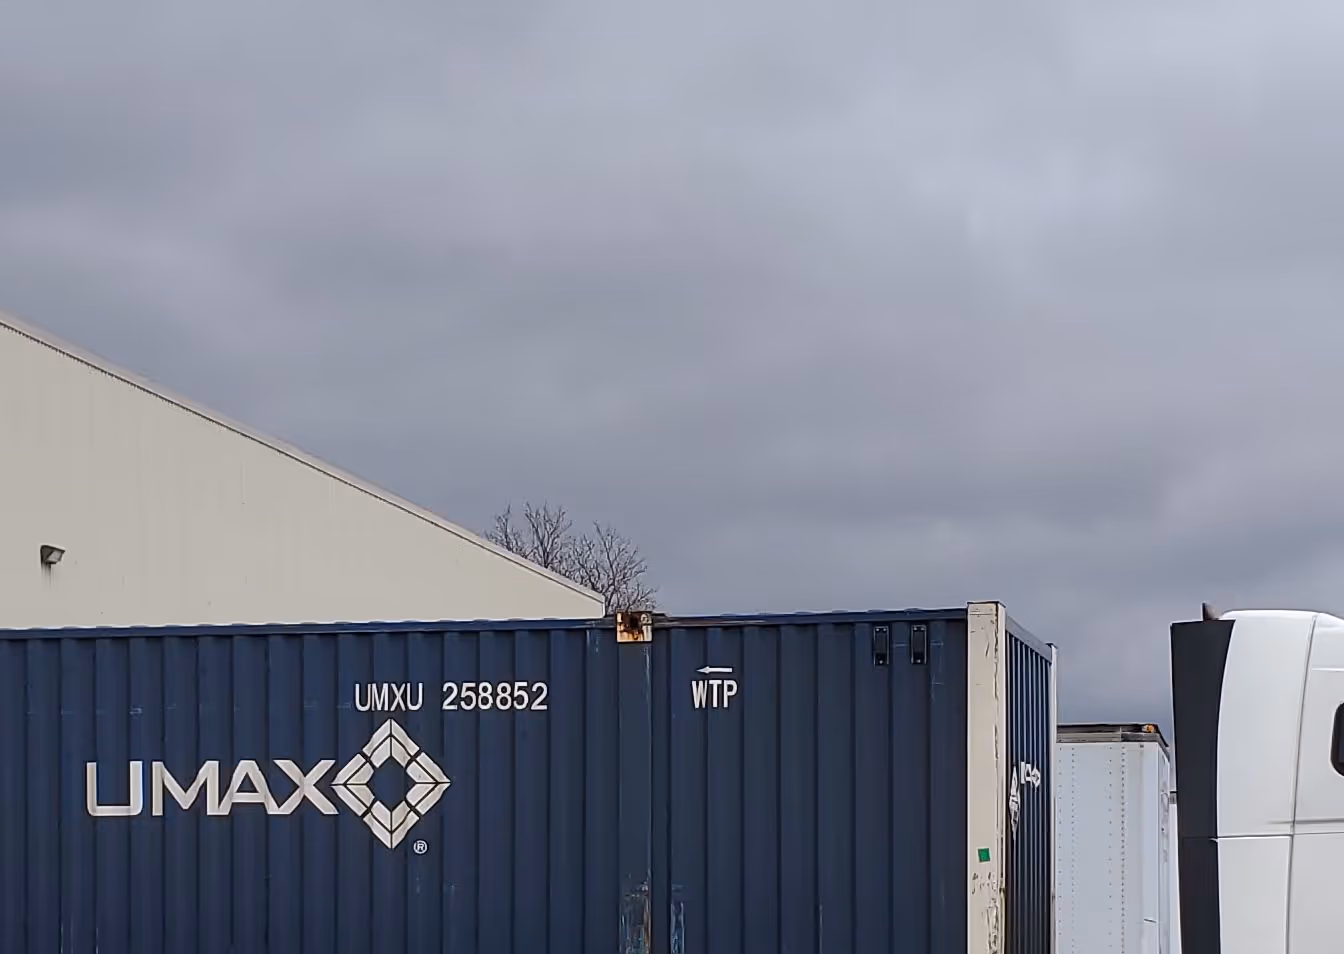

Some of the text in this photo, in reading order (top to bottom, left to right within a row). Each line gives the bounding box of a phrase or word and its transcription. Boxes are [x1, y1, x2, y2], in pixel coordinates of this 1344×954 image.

[353, 680, 549, 712] UMXU 258852
[690, 678, 738, 709] WTP
[85, 758, 339, 818] UMAX
